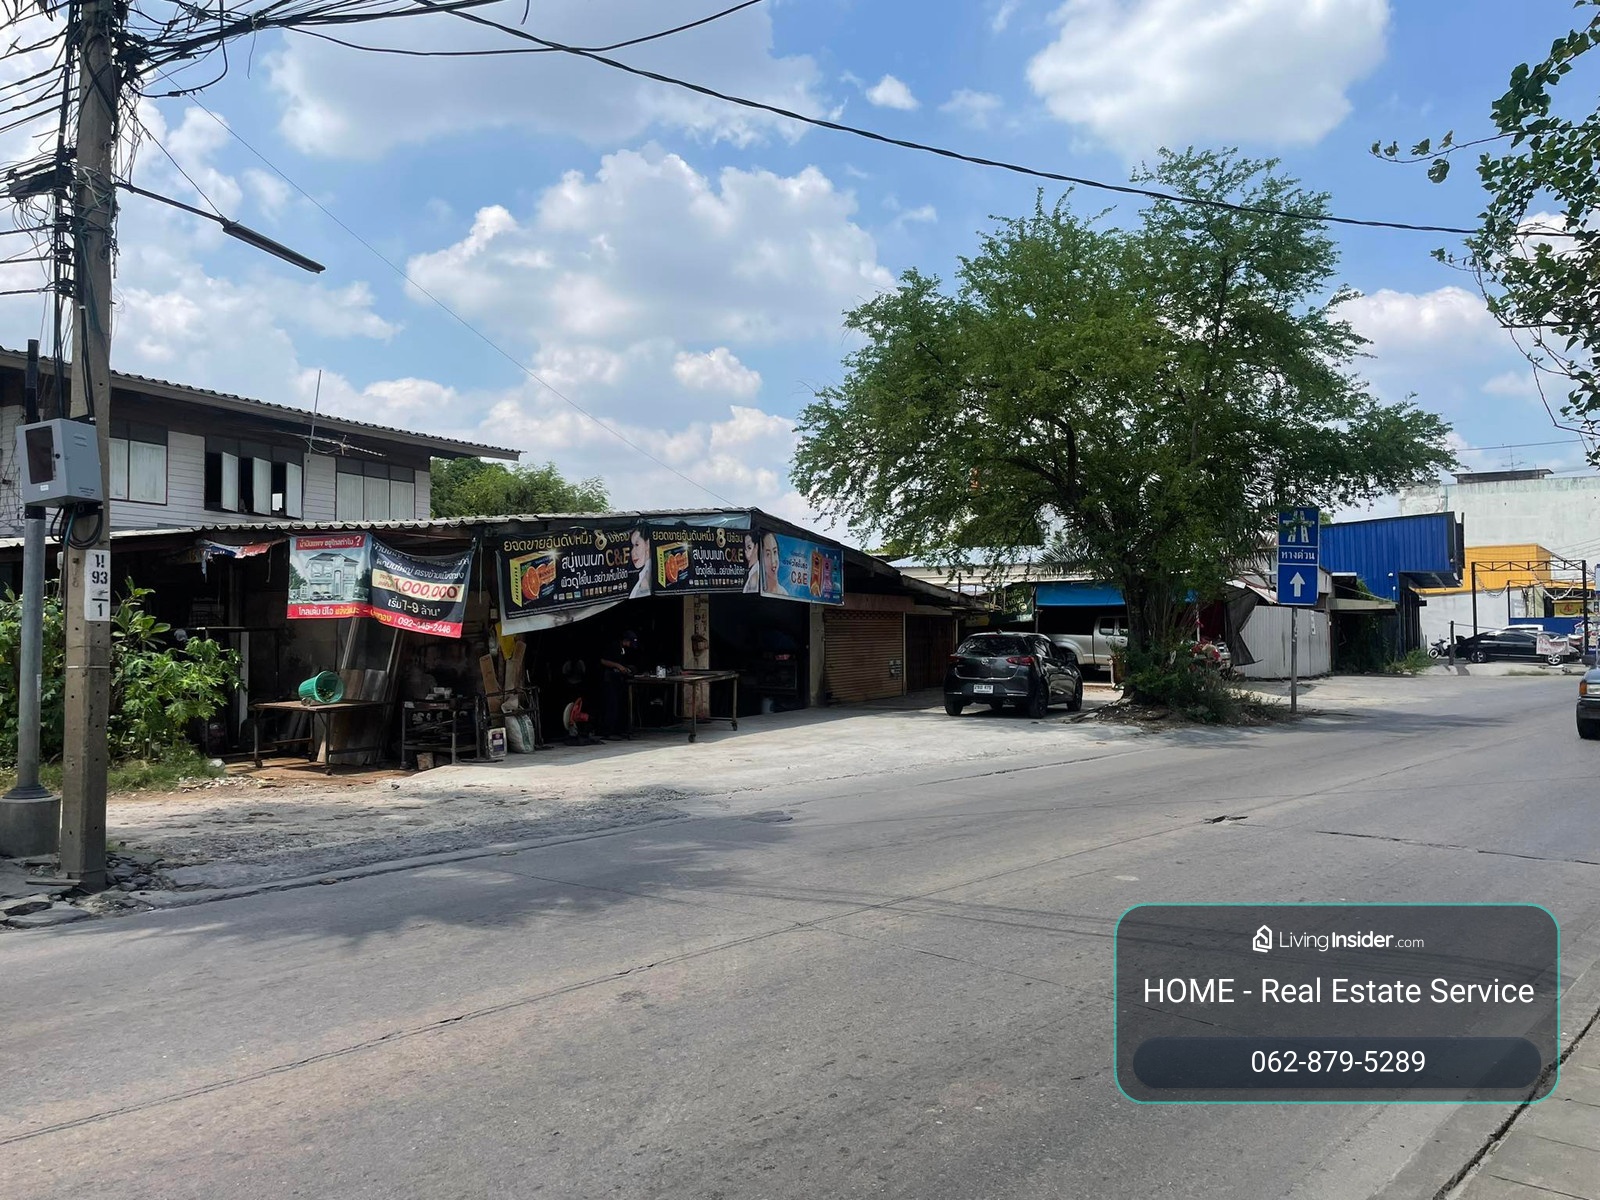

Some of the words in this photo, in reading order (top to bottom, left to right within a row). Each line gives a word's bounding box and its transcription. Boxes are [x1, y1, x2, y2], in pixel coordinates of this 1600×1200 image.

[503, 530, 592, 551] ยอดขายอันดับหนึ่ง
[594, 529, 607, 550] 8
[652, 527, 715, 541] ยอดขายอันดับหนึ่ง
[716, 528, 726, 548] 8
[605, 547, 630, 567] C&E
[725, 548, 744, 563] C&E
[1281, 549, 1316, 560] ทางด่วน
[92, 571, 108, 584] 93
[791, 570, 808, 585] C&E
